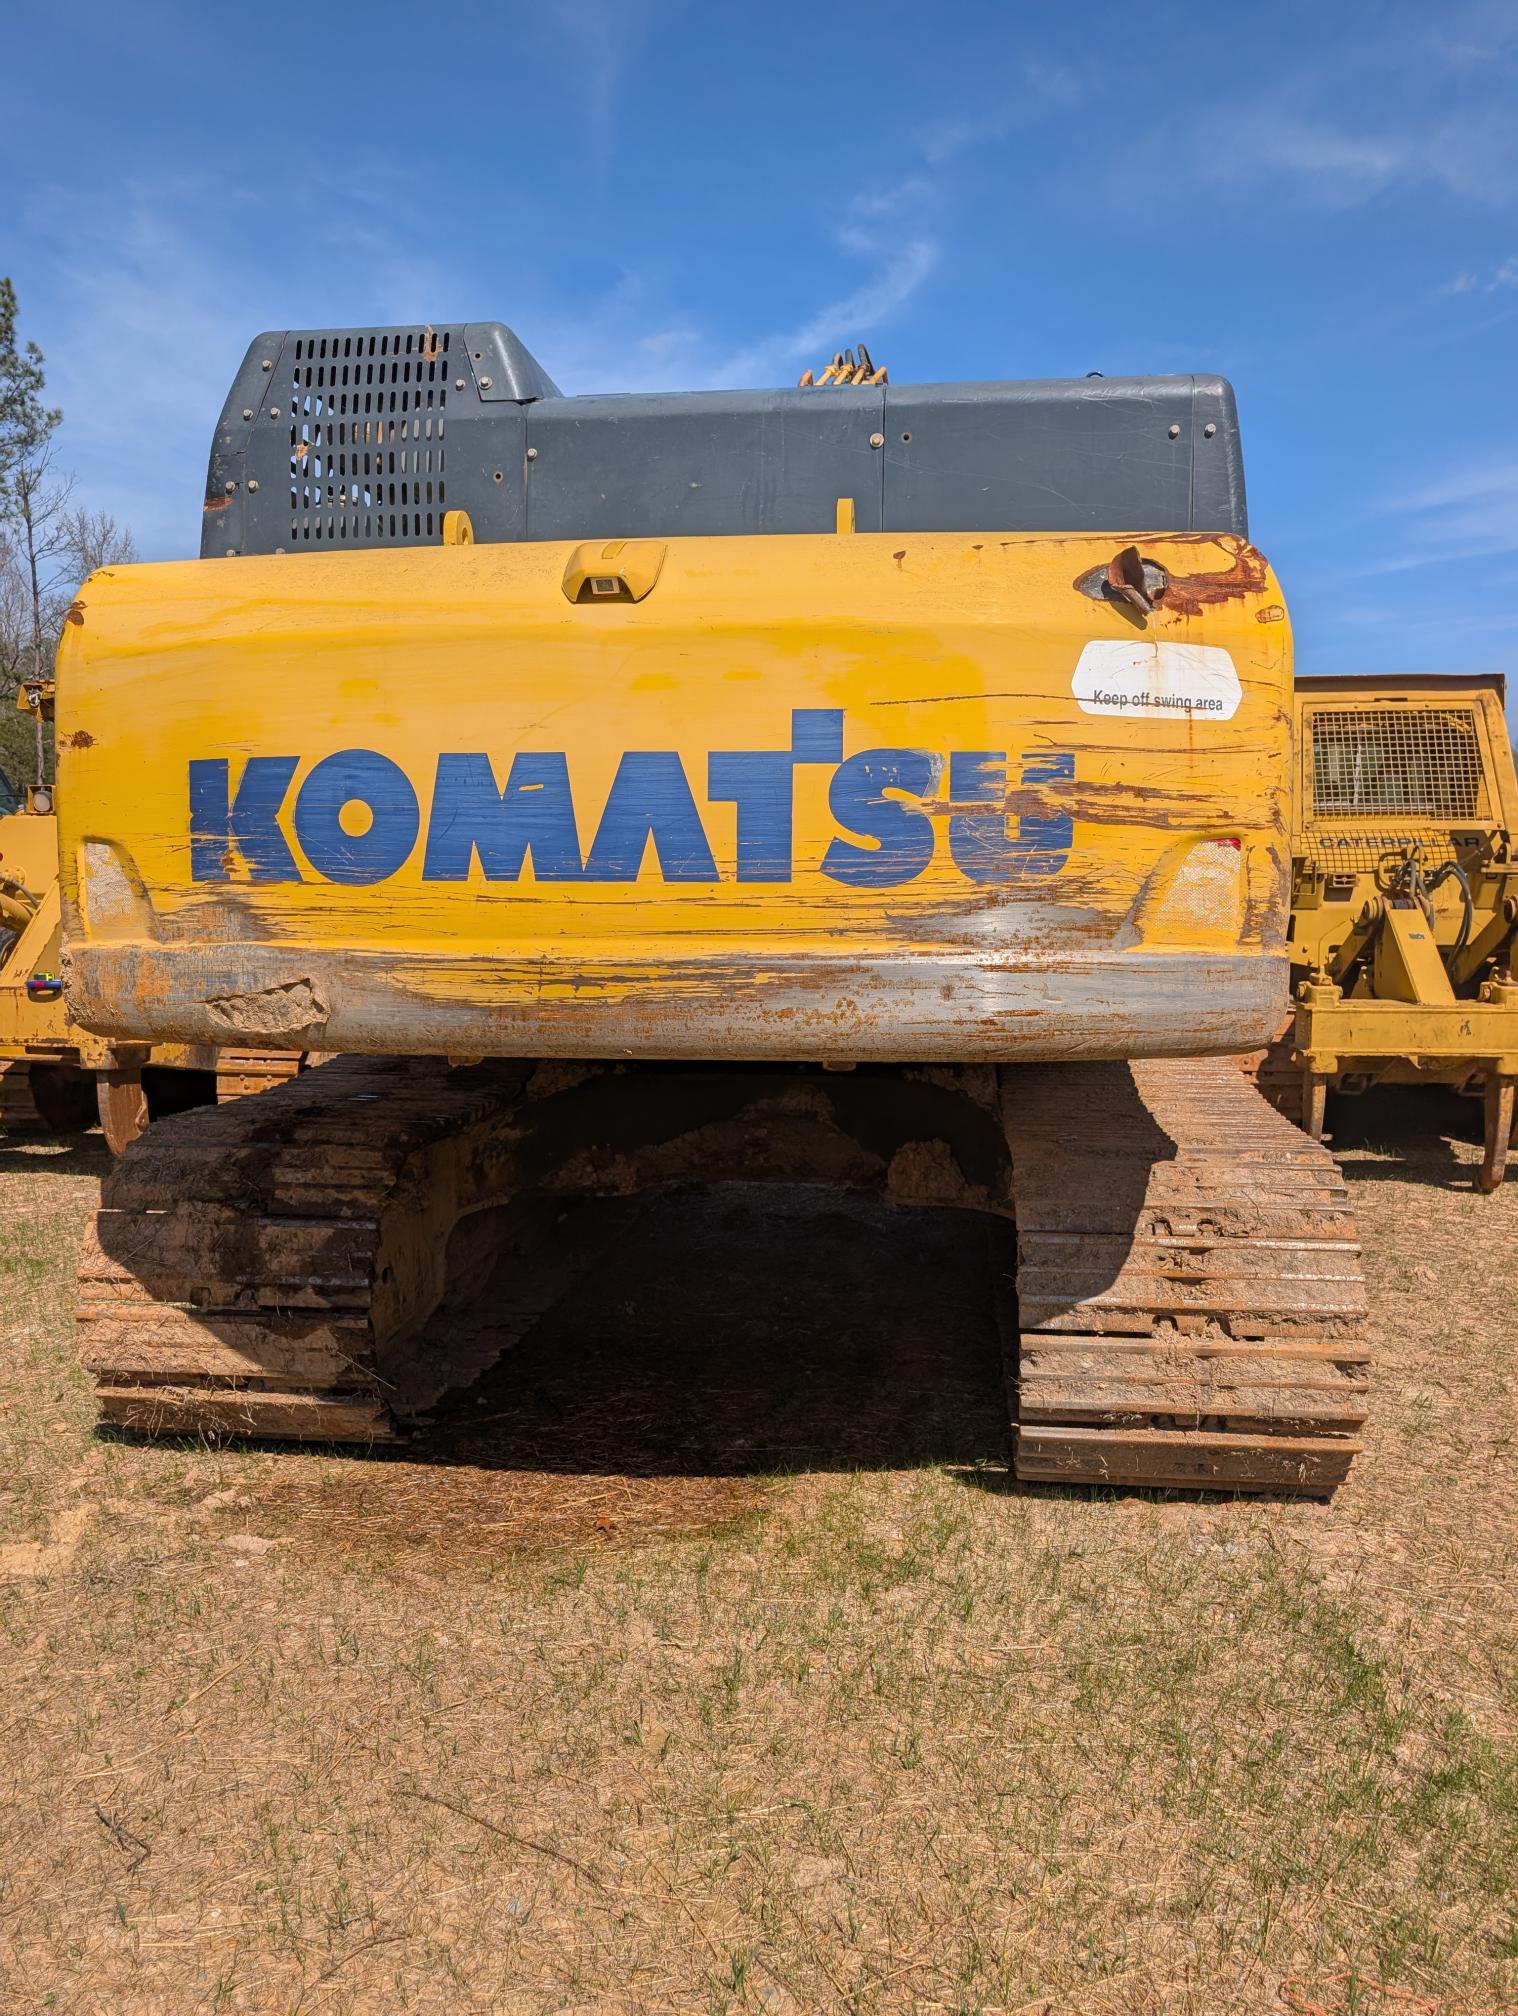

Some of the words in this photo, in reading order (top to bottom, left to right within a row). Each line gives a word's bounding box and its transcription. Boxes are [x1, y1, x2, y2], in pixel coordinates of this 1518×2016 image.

[1093, 689, 1129, 710] Keep
[1132, 691, 1150, 706] off
[1154, 692, 1192, 713] swing
[1195, 697, 1223, 711] area
[188, 709, 1075, 887] KOMATSU
[1319, 837, 1480, 849] CATERPILLAR
